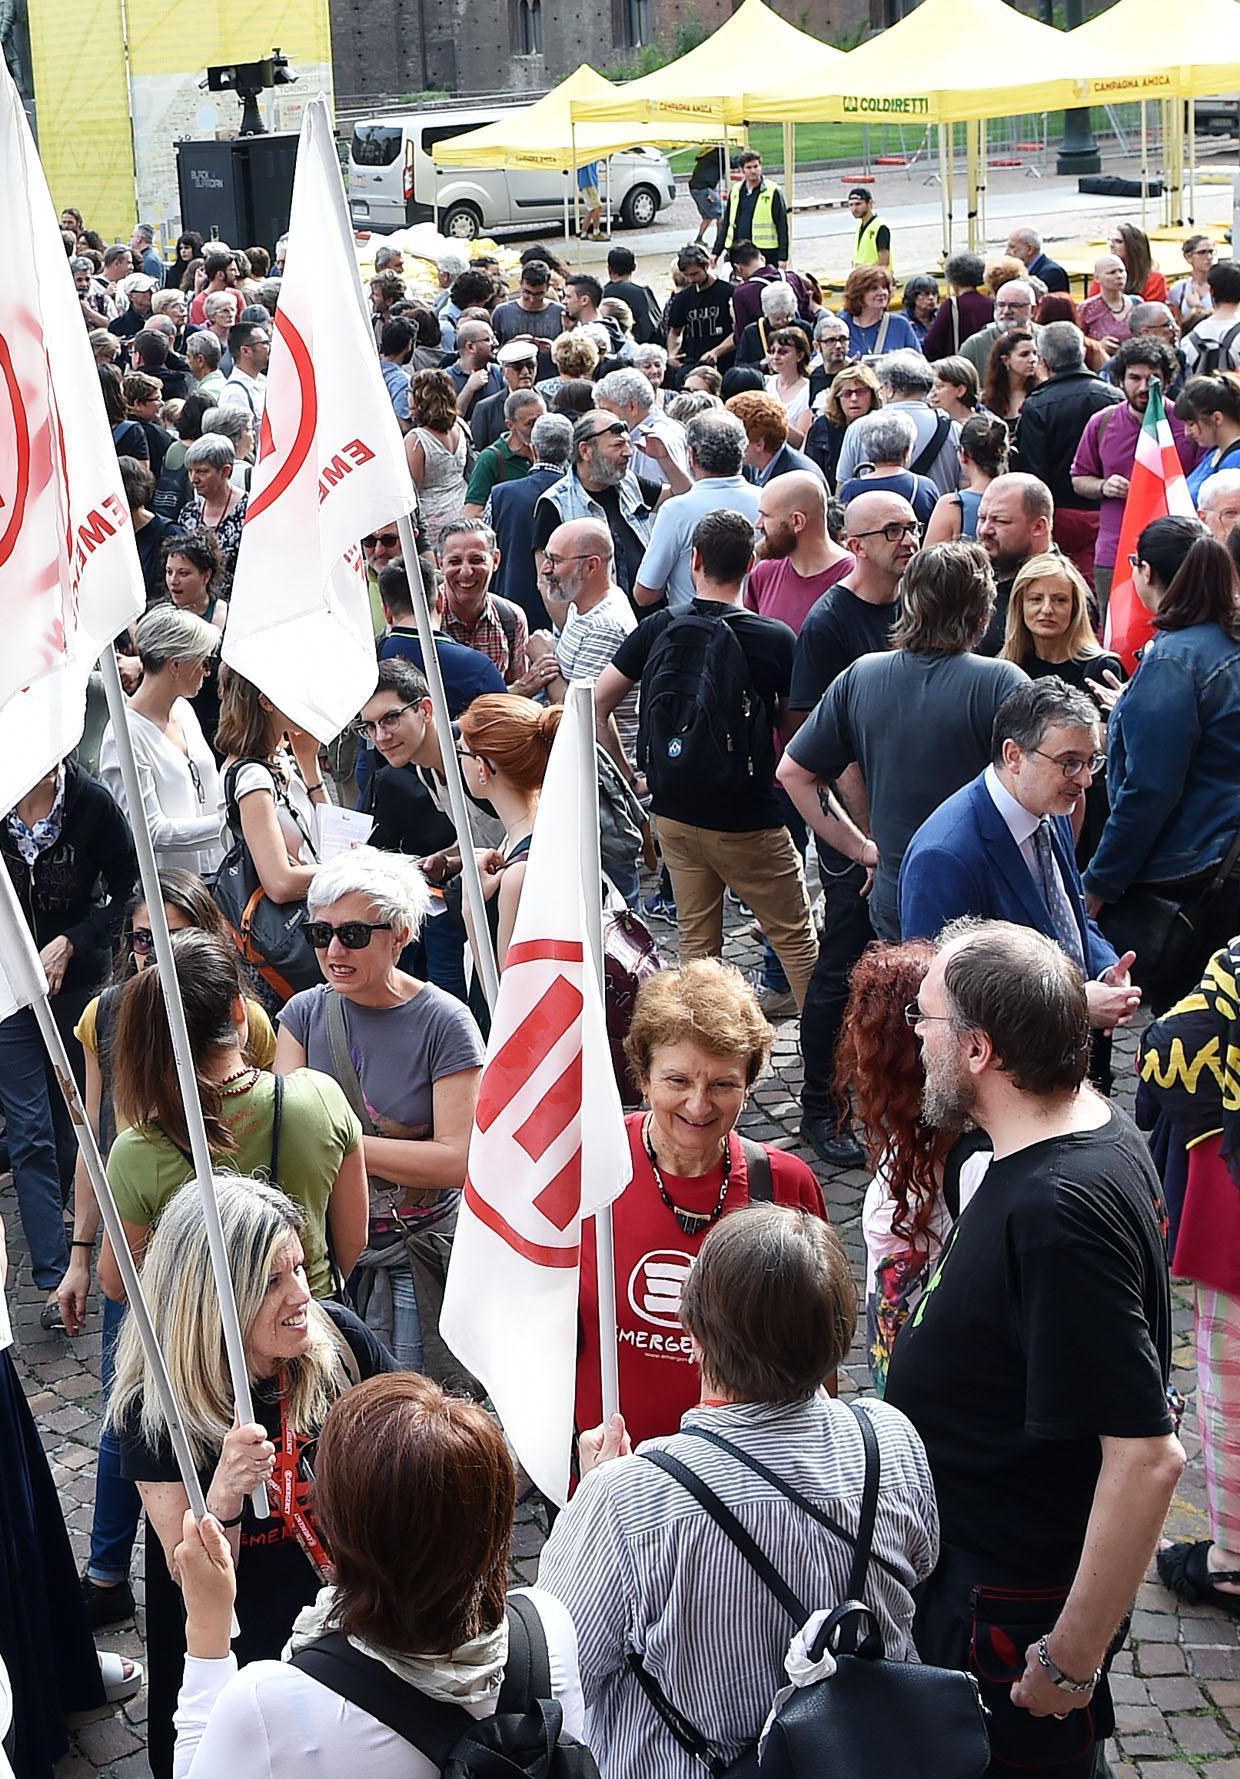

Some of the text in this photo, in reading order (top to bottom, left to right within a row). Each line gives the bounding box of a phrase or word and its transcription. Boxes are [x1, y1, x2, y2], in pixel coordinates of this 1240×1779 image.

[1094, 75, 1171, 92] CAMPAGNA AMICA
[860, 97, 929, 113] COLDIRETTI
[615, 1325, 694, 1364] MERGE
